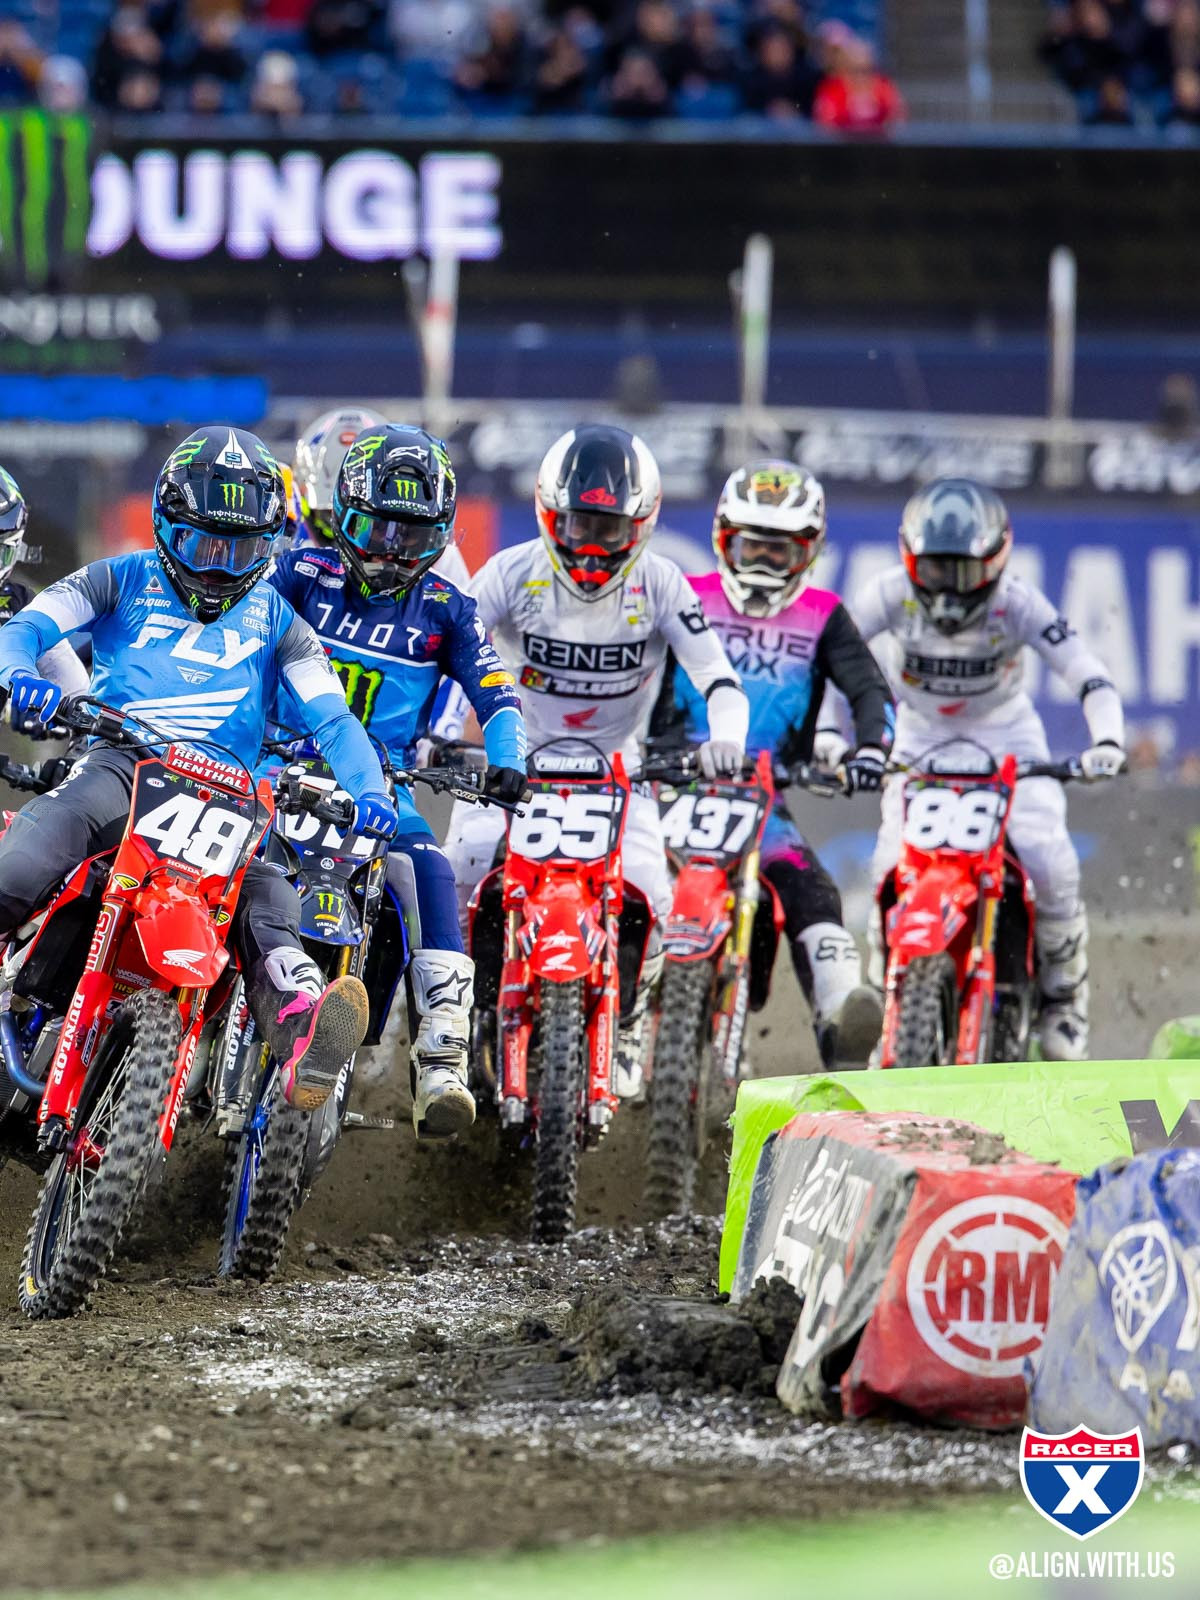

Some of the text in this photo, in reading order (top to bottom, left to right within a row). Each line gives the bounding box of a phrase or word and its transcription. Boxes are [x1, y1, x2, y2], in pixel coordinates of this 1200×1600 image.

[207, 508, 257, 523] MONSTER
[382, 498, 430, 511] MONSTER
[133, 597, 172, 609] SHOWA
[128, 612, 267, 670] FLY
[171, 757, 246, 790] RENTHAL
[174, 749, 249, 779] RENTHAL
[133, 792, 253, 877] 48
[509, 792, 622, 859] 65
[660, 794, 759, 854] 437
[166, 858, 201, 876] HONDA
[161, 958, 205, 979] HONDA
[53, 993, 86, 1085] DUNLOP
[227, 984, 247, 1071] UNLOP
[169, 1035, 197, 1133] DUNLOP
[508, 1033, 520, 1088] OOSIER
[945, 1250, 1051, 1324] RM
